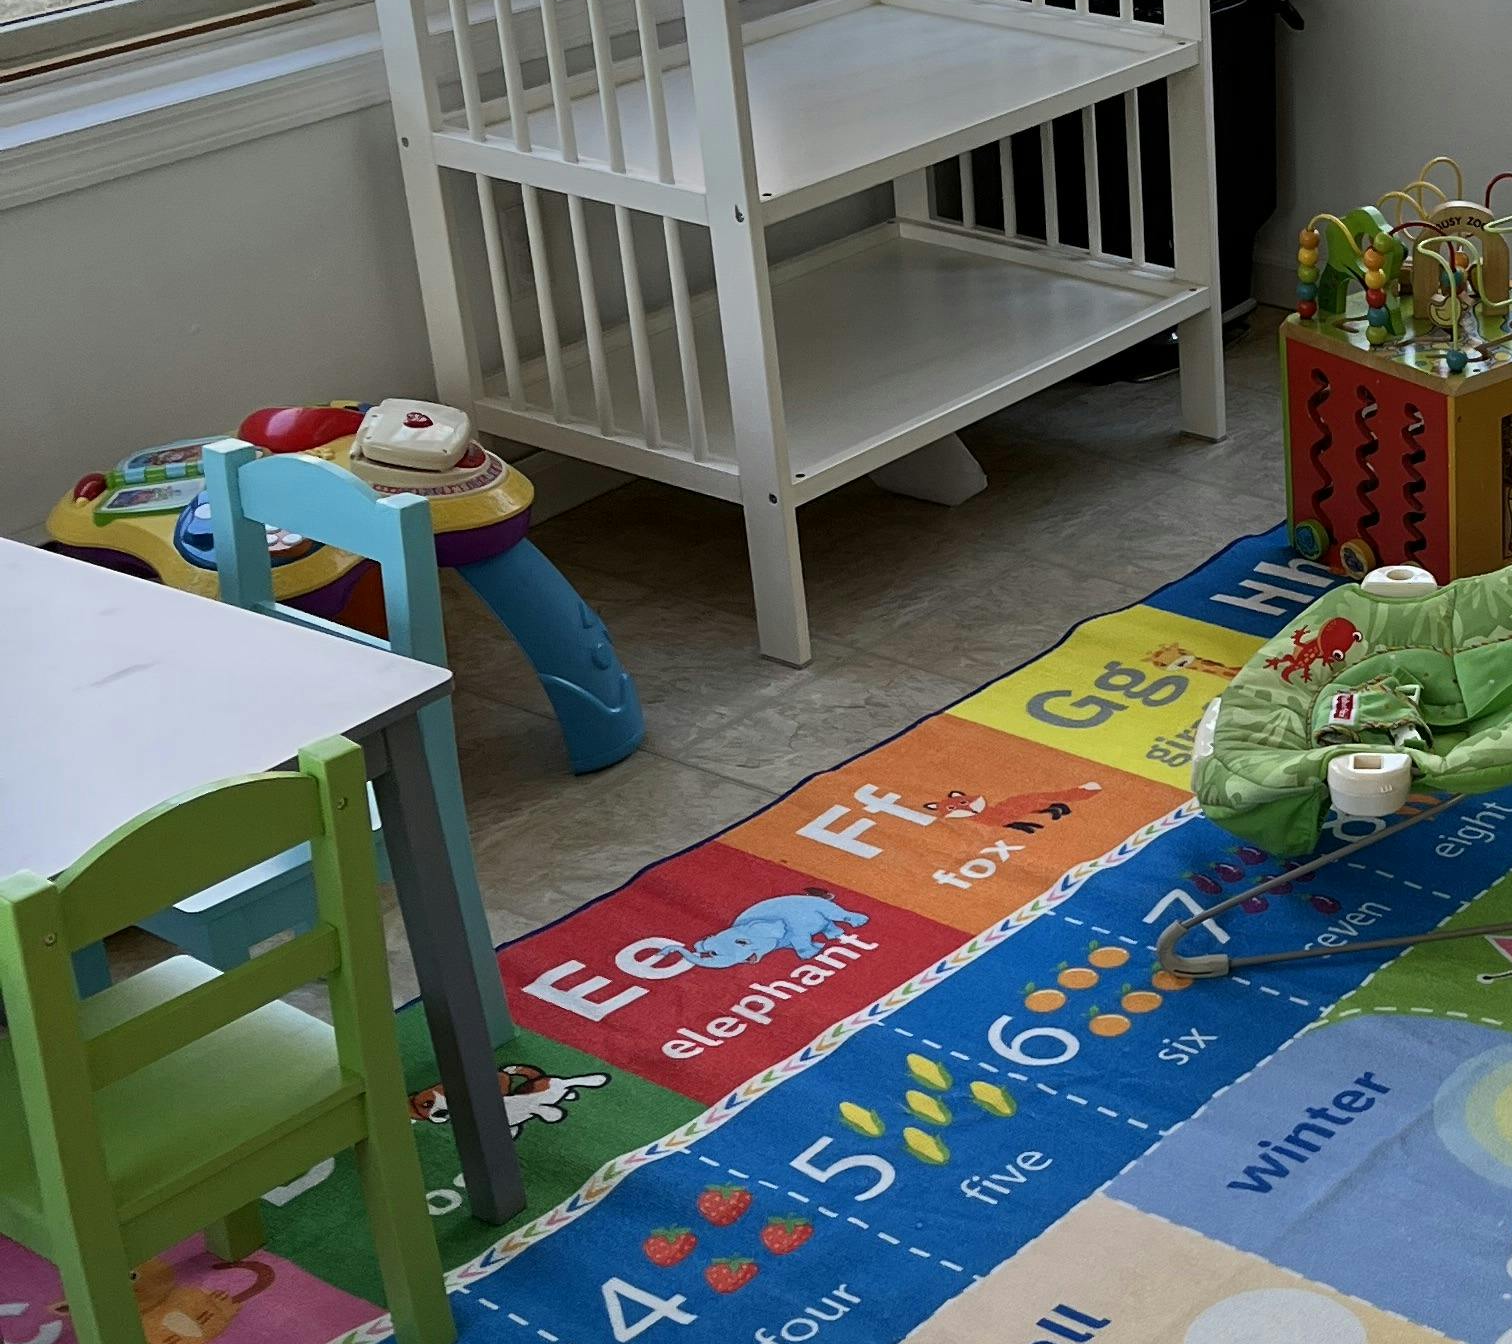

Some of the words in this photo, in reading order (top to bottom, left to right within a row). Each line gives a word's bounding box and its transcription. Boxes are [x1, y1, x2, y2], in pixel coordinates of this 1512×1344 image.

[1436, 216, 1462, 231] USY
[1210, 558, 1335, 616] Hh
[1026, 661, 1190, 729] Gg
[795, 783, 938, 860] Ff
[932, 840, 1026, 890] fox
[1304, 902, 1392, 951] even
[522, 936, 695, 1022] Ee
[661, 932, 878, 1060] elephant
[987, 1014, 1080, 1066] 6
[1158, 1028, 1218, 1065] six
[1227, 1071, 1392, 1197] winter
[790, 1135, 896, 1201] 5
[960, 1150, 1053, 1206] five
[601, 1276, 698, 1343] 4
